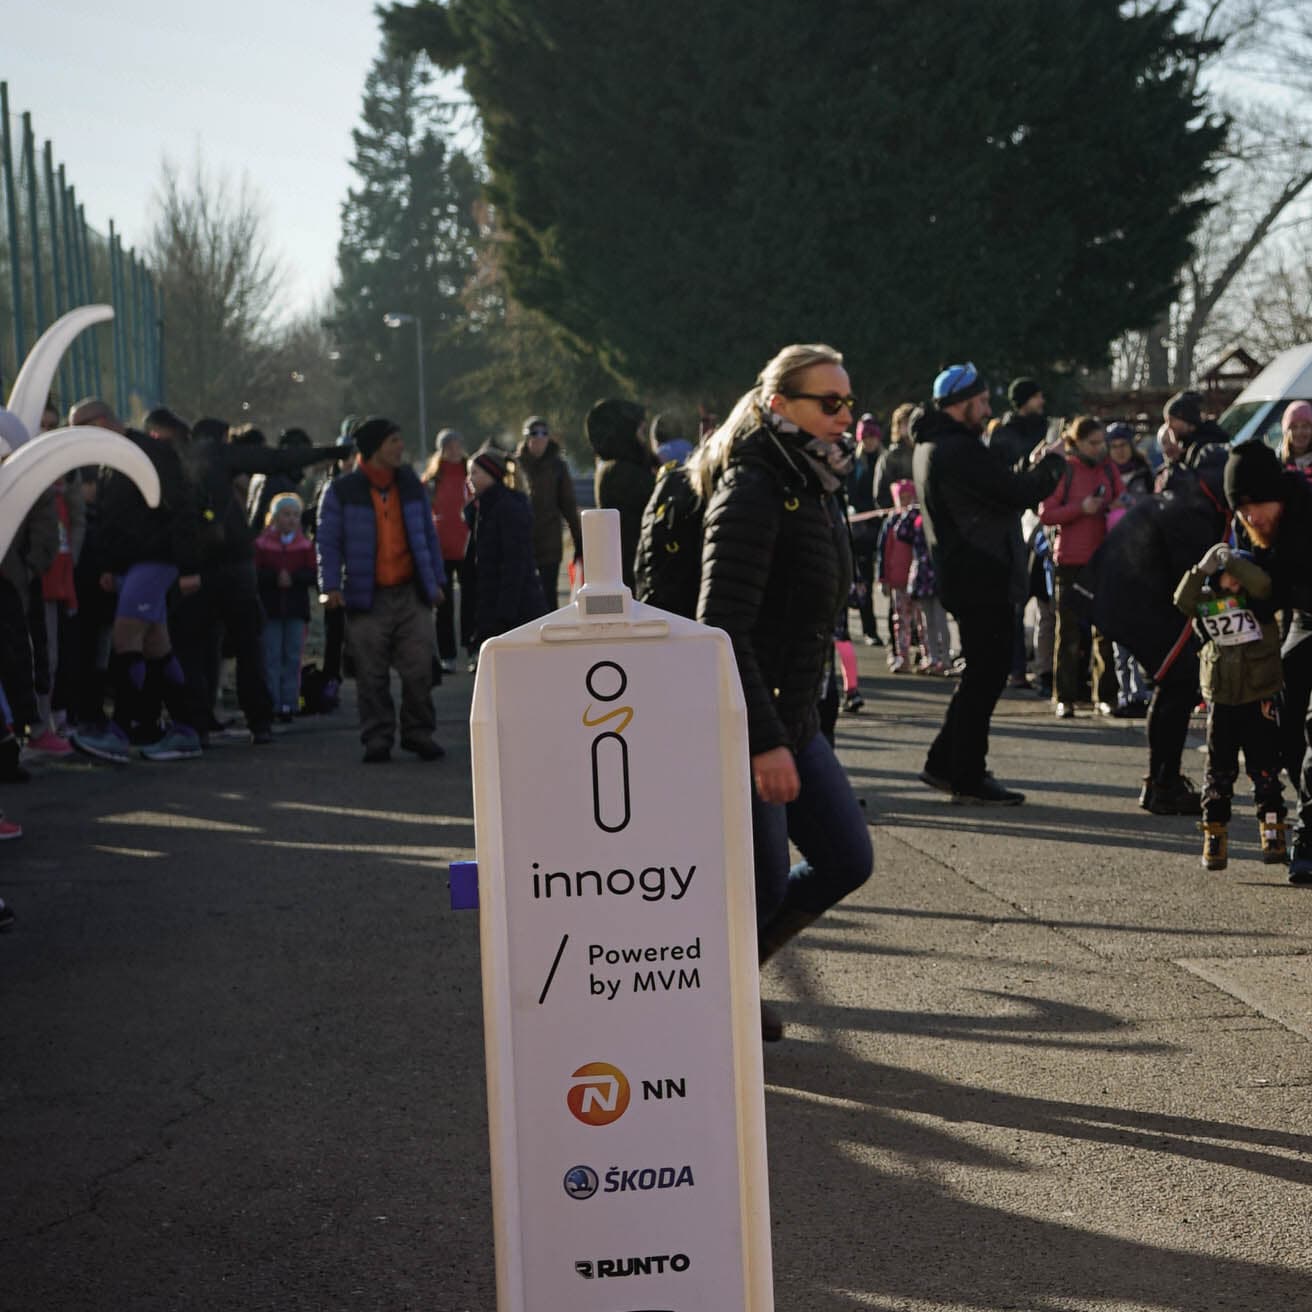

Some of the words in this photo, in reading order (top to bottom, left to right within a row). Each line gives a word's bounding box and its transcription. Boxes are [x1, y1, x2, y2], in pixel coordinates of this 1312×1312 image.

[1206, 611, 1257, 637] 3279
[532, 862, 698, 903] innogy
[588, 937, 702, 966] Powered
[589, 973, 621, 1001] by
[633, 967, 702, 993] MVM
[641, 1077, 687, 1101] NN
[603, 1164, 695, 1194] ŠKODA
[597, 1253, 691, 1278] RUNTO
